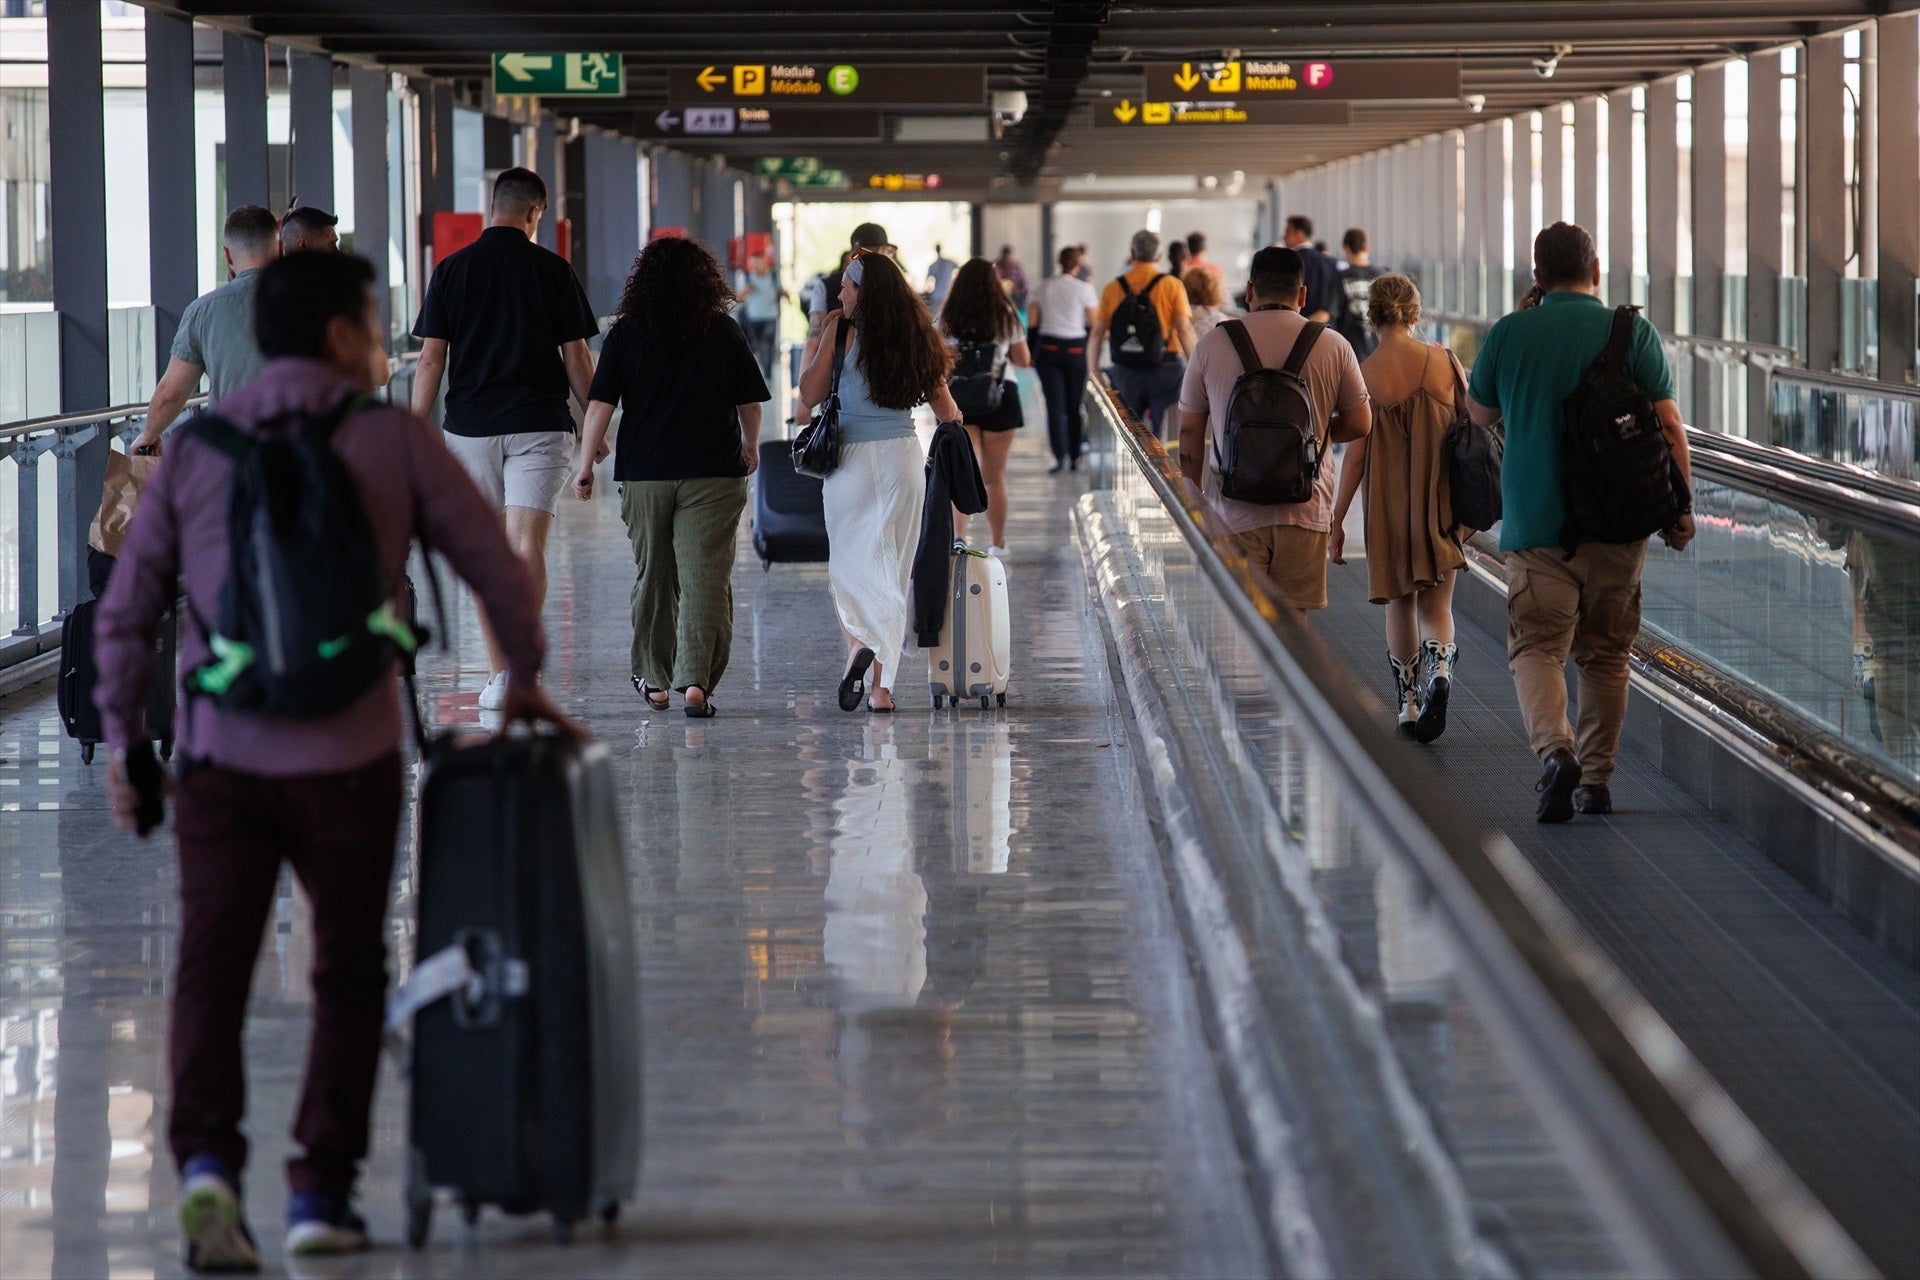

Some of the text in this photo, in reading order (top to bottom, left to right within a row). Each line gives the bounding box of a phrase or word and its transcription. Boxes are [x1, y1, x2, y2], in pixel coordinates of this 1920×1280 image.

[771, 65, 816, 78] Module
[1246, 62, 1290, 75] Module
[1310, 64, 1326, 86] F
[743, 69, 757, 89] P
[836, 69, 851, 90] E
[1246, 76, 1297, 91] Módulo
[1224, 108, 1247, 122] Bus
